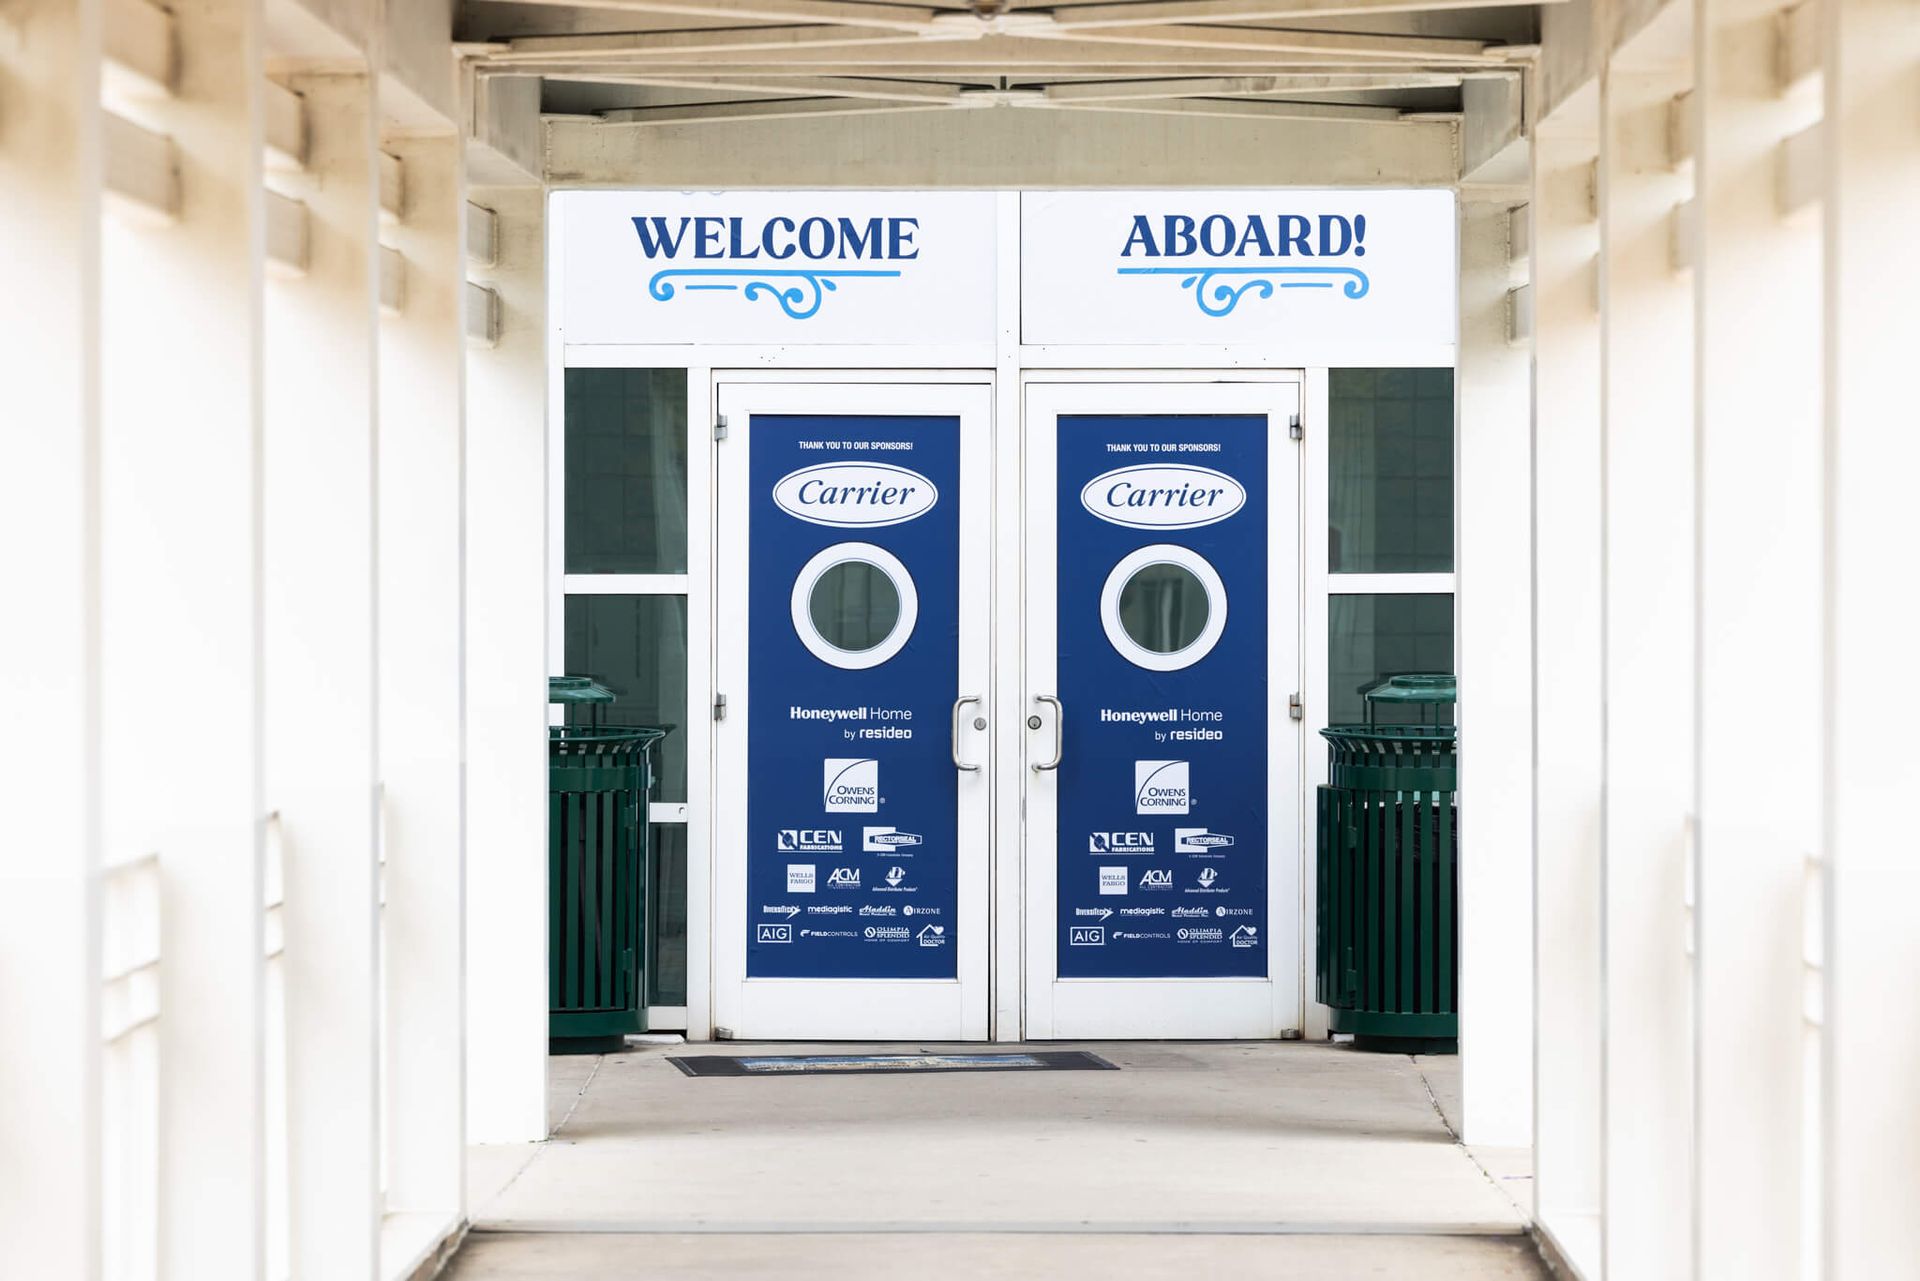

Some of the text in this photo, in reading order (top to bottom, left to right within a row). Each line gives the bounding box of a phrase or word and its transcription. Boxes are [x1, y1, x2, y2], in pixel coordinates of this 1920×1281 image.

[631, 217, 920, 260] WELCOME
[1120, 214, 1366, 257] ABOARD!
[799, 441, 913, 450] THANK YOU TO OUR SPONSORS!
[1106, 443, 1221, 452] THANK YOU TO OUR SPONSORS!
[798, 479, 915, 505] Carrier
[1107, 482, 1223, 507] Carrier
[790, 706, 912, 722] Honeywell Home
[1100, 708, 1223, 725] Honeywell Home
[844, 726, 912, 741] by resideo
[1155, 728, 1223, 742] by resideo
[837, 785, 875, 795] OWENS
[1148, 787, 1186, 797] OWENS
[829, 795, 875, 805] CORNING
[1140, 797, 1186, 806] CORNING
[800, 830, 842, 844] CEN
[1112, 832, 1154, 846] CEN
[827, 868, 860, 883] ACM
[1139, 870, 1172, 885] ACM
[761, 928, 787, 939] AIG
[1074, 930, 1100, 942] AIG
